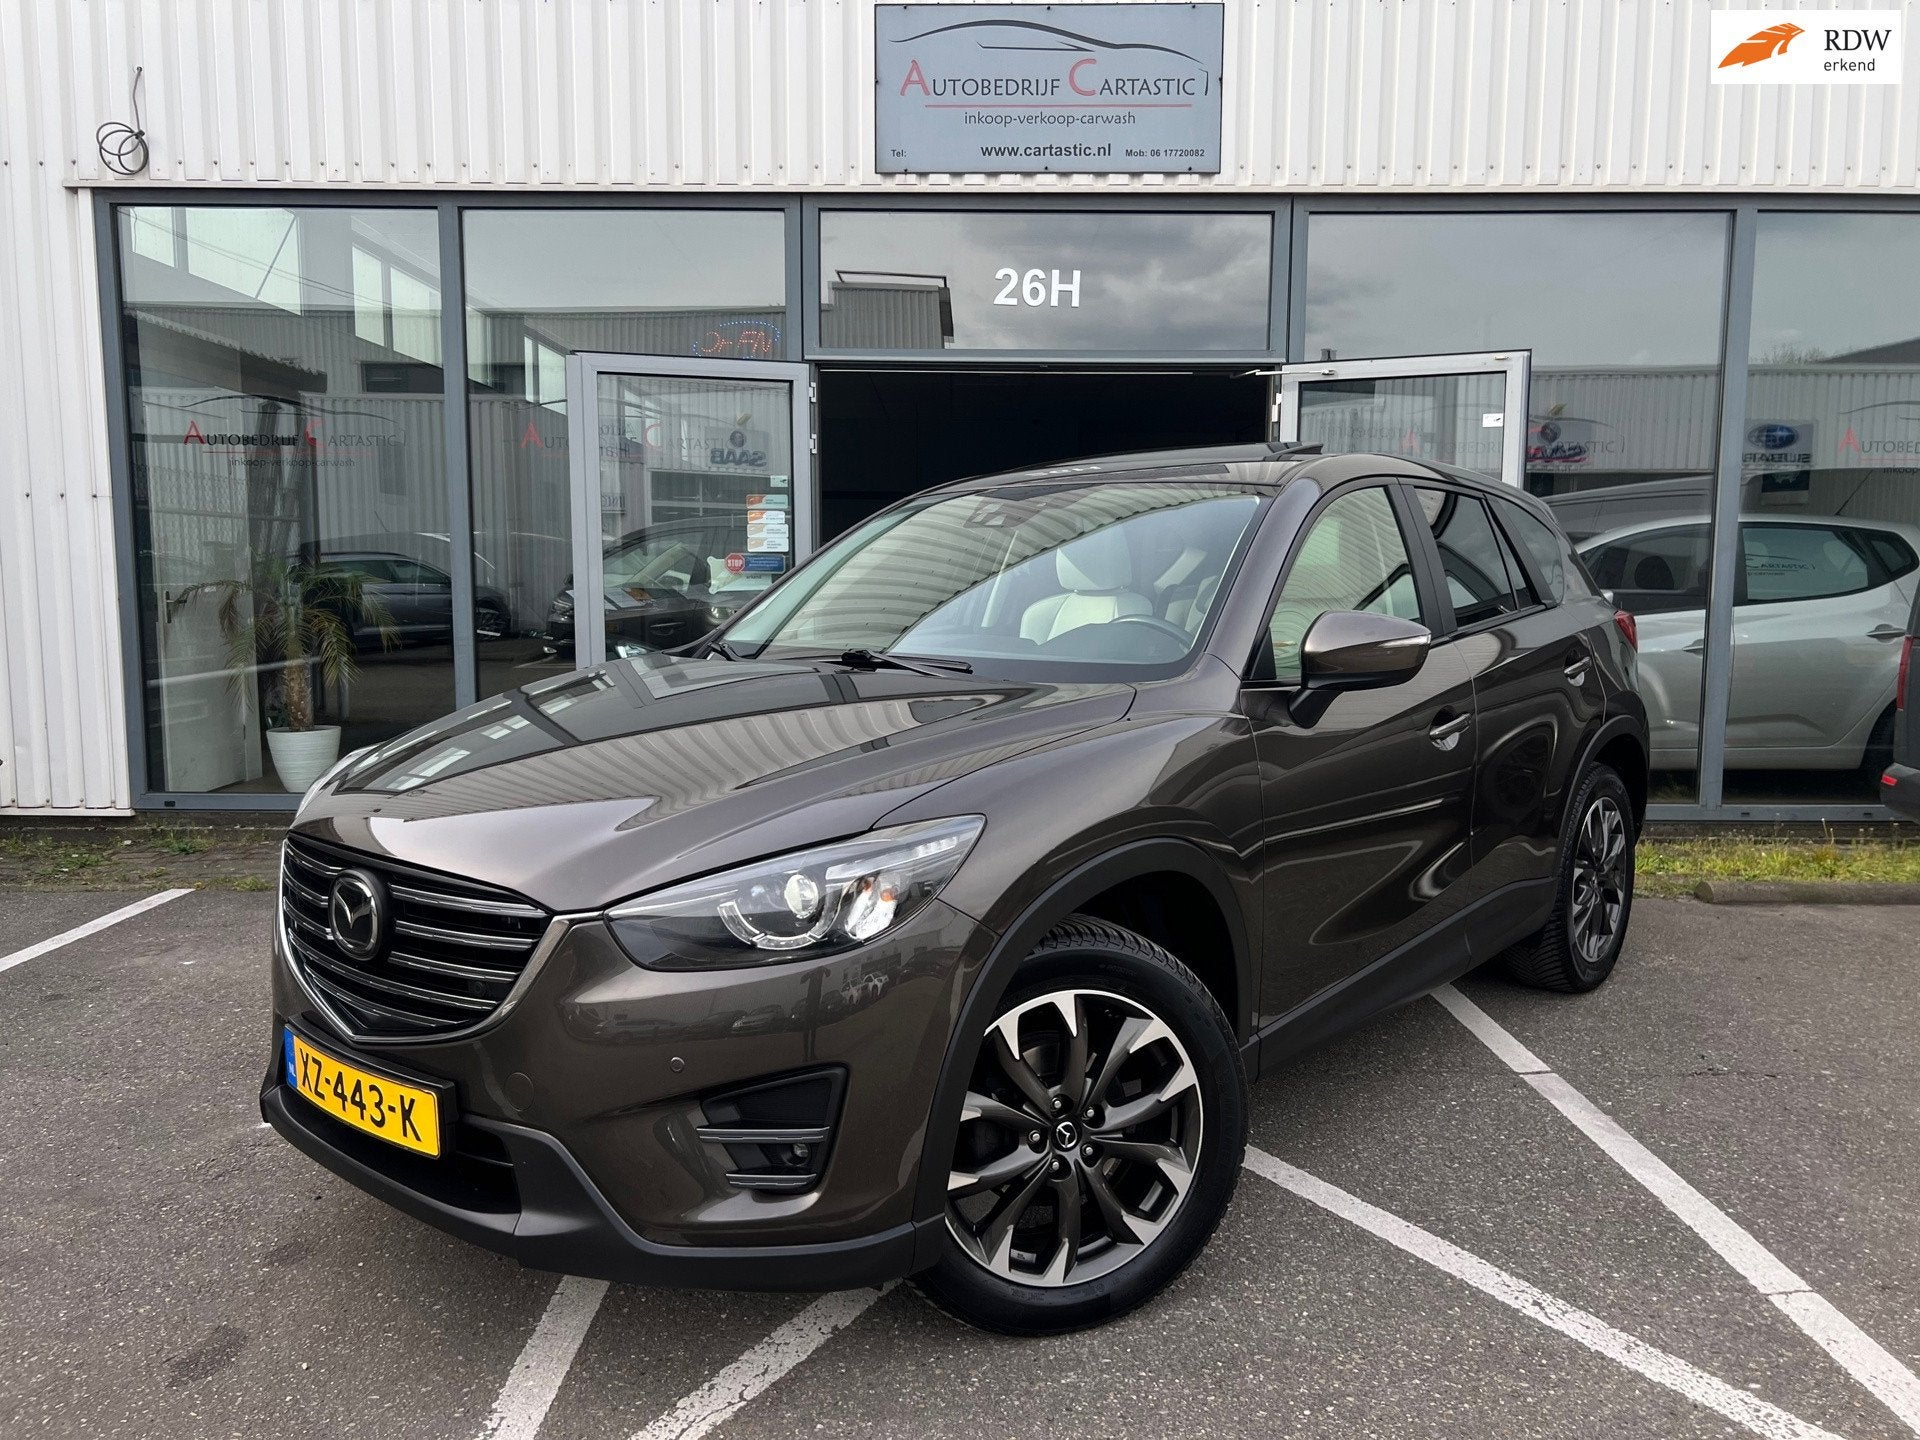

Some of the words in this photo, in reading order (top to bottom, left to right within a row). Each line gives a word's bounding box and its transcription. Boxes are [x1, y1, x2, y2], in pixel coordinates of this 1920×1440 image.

[900, 59, 1060, 97] AUTOBEDRIJF
[1068, 58, 1196, 97] CARTASTIC
[964, 111, 1136, 127] inkoop-verkoop-carwash
[890, 149, 907, 158] Tel:
[980, 143, 1112, 158] www.cartastic.nl
[1125, 149, 1148, 158] Mob:
[1150, 149, 1161, 158] 06
[1163, 149, 1205, 158] 17720082
[993, 267, 1081, 308] 26H
[727, 559, 743, 567] STOP
[300, 1047, 423, 1143] XZ-443-K
